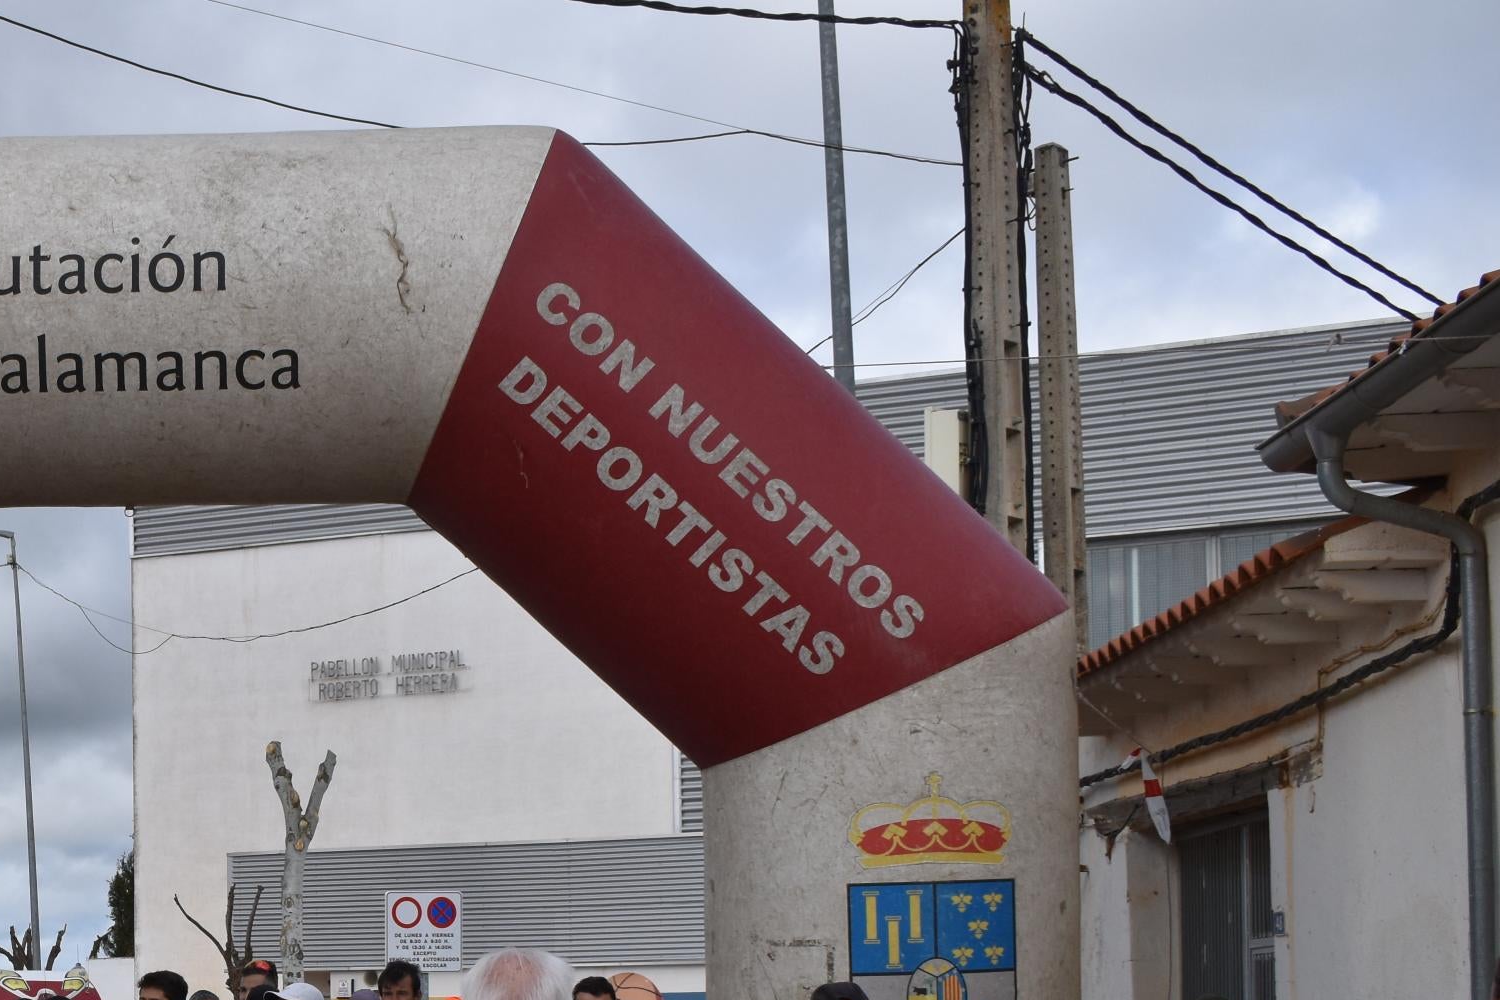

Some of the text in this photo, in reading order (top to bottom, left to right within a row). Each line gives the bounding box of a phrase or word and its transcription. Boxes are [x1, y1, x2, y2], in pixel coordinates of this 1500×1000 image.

[498, 355, 845, 675] DEPORTISTAS
[536, 283, 925, 639] CON NUESTROS
[310, 650, 466, 682] PABELLON MUNICIPAL
[318, 679, 379, 700] ROBERTO
